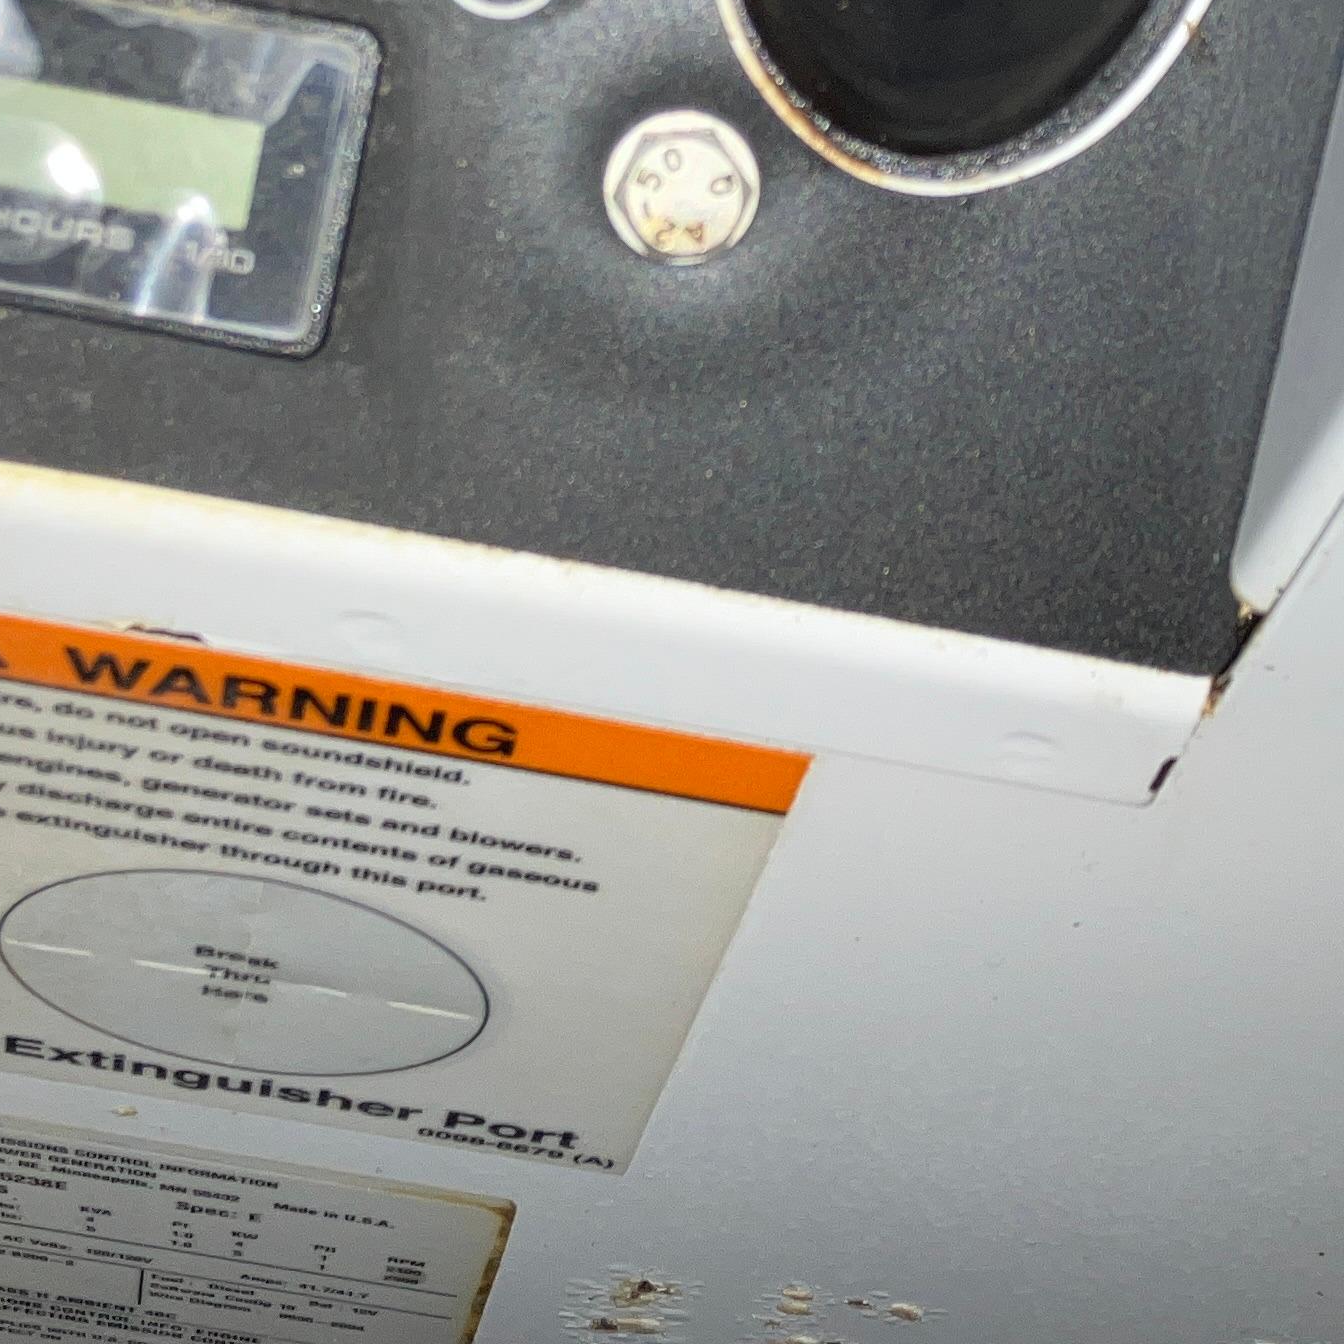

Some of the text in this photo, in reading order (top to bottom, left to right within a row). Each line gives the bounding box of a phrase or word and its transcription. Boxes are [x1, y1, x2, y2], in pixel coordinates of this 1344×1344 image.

[65, 646, 517, 757] WARNING
[53, 701, 96, 720] do
[105, 710, 160, 731] not
[169, 722, 250, 749] open
[262, 738, 470, 786] soundshield.
[47, 727, 139, 759] injury
[149, 747, 184, 764] or
[192, 754, 283, 784] death
[292, 771, 367, 798] from
[378, 787, 438, 809] fire.
[17, 780, 174, 821] discharge
[182, 805, 273, 838] entire
[282, 829, 419, 863] contents
[428, 853, 457, 870] of
[468, 860, 600, 894] gaseous
[140, 774, 297, 813] generator
[306, 804, 372, 826] sets
[382, 817, 440, 839] and
[449, 829, 583, 864] blowers.
[16, 808, 210, 854] extinguisher
[220, 843, 341, 877] through
[350, 867, 408, 889] this
[416, 878, 488, 904] port.
[194, 943, 280, 972] Break
[204, 965, 273, 986] Thru
[200, 984, 270, 1005] Here
[4, 1033, 424, 1122] Extinguisher
[444, 1108, 580, 1150] Port
[48, 1154, 157, 1179] GENERATION
[74, 1148, 152, 1169] CONTROL
[159, 1163, 278, 1189] INFORMATION
[573, 1153, 615, 1170] (A)
[159, 1183, 187, 1195] MN
[273, 1202, 317, 1216] Made
[323, 1210, 338, 1219] in
